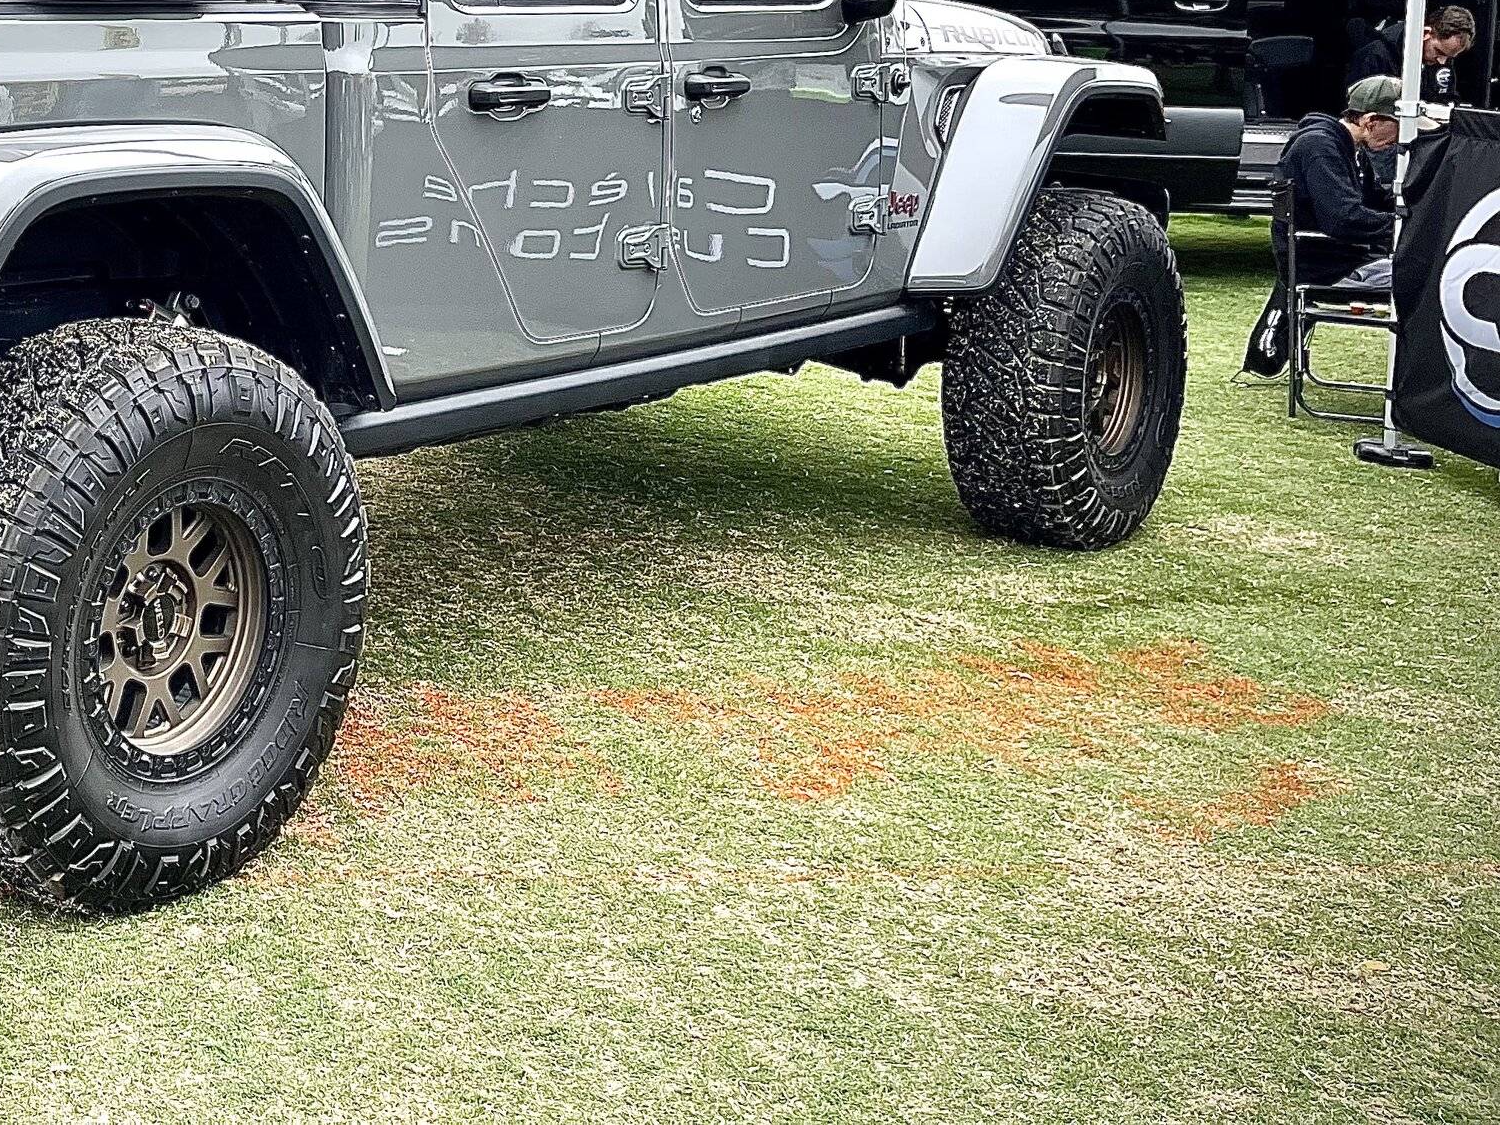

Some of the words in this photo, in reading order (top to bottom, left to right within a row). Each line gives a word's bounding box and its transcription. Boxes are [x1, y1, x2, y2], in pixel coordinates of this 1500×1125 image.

[888, 189, 920, 218] Jeep
[887, 219, 919, 230] LADIATOR
[153, 598, 165, 639] WELD
[248, 680, 309, 787] RIDGE
[106, 777, 249, 832] GRAPPLER
